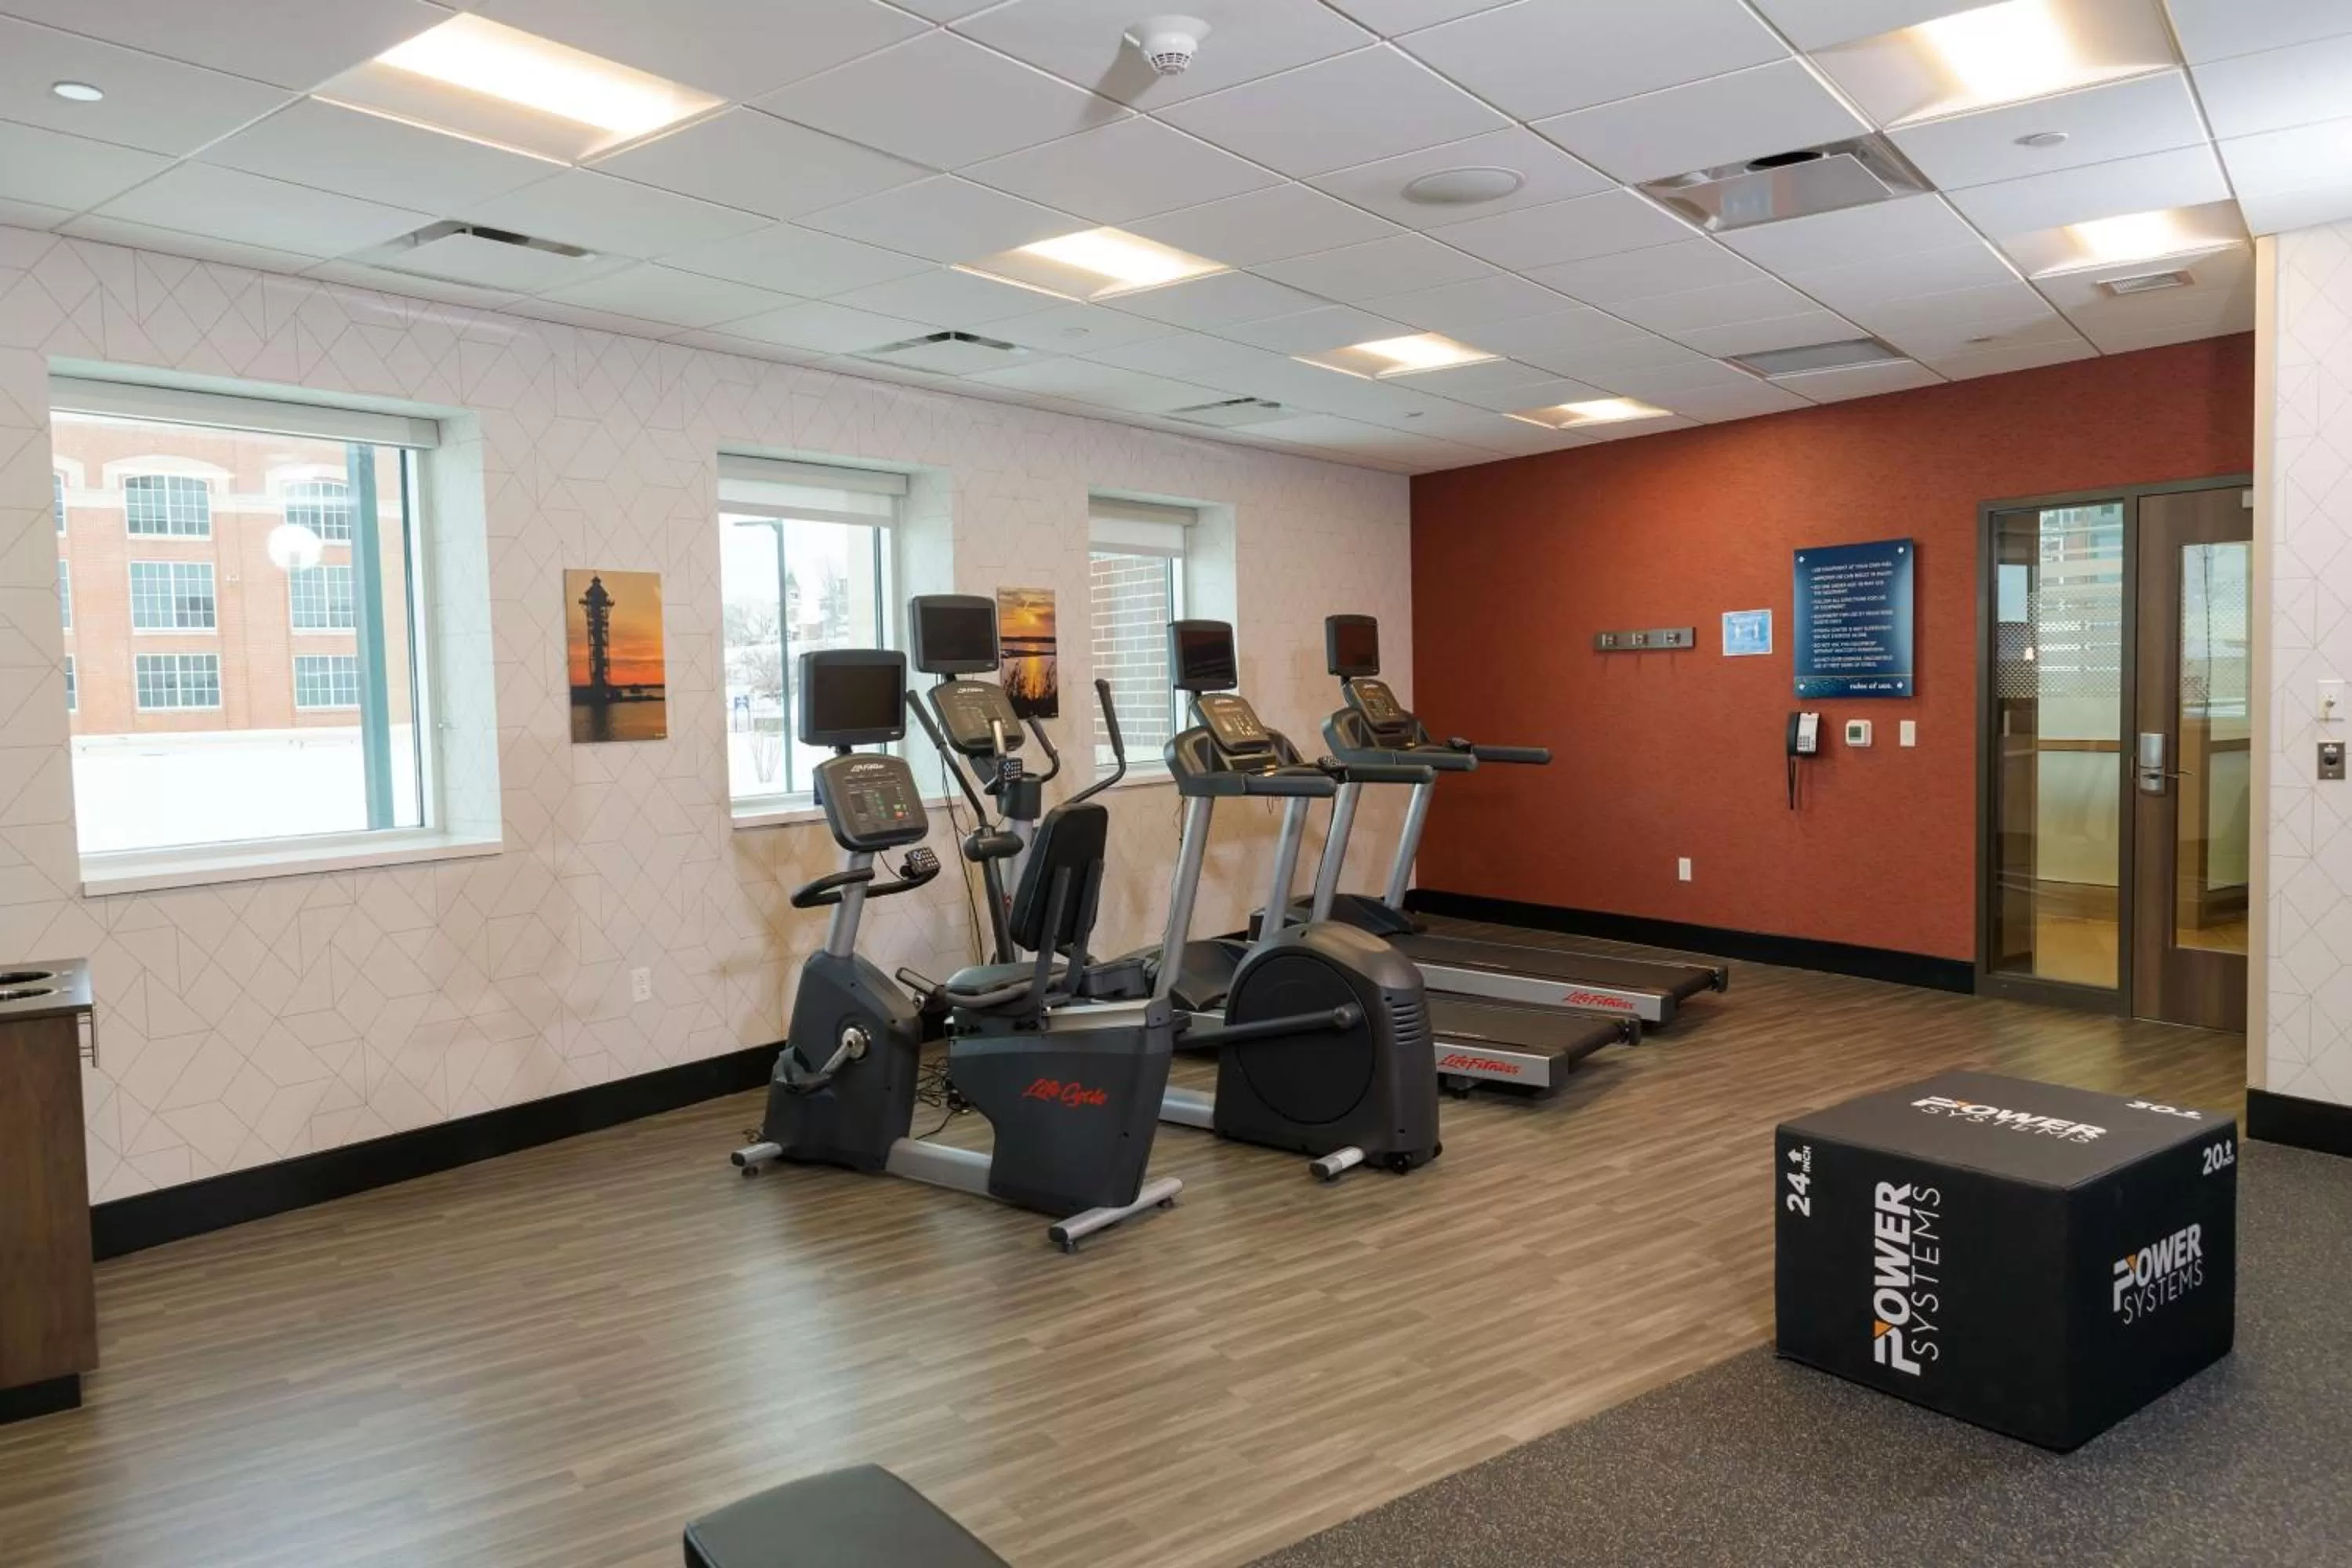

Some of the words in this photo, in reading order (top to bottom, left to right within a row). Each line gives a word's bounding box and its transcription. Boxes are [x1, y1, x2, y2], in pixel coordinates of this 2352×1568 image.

[1911, 1096, 2107, 1139] POWER
[2202, 1143, 2223, 1176] 20
[1786, 1172, 1810, 1217] 24
[1873, 1181, 1920, 1376] POWER
[1911, 1186, 1940, 1361] SYSTEMS
[2114, 1223, 2203, 1312] POWER
[2123, 1259, 2202, 1325] SYSTEMS
